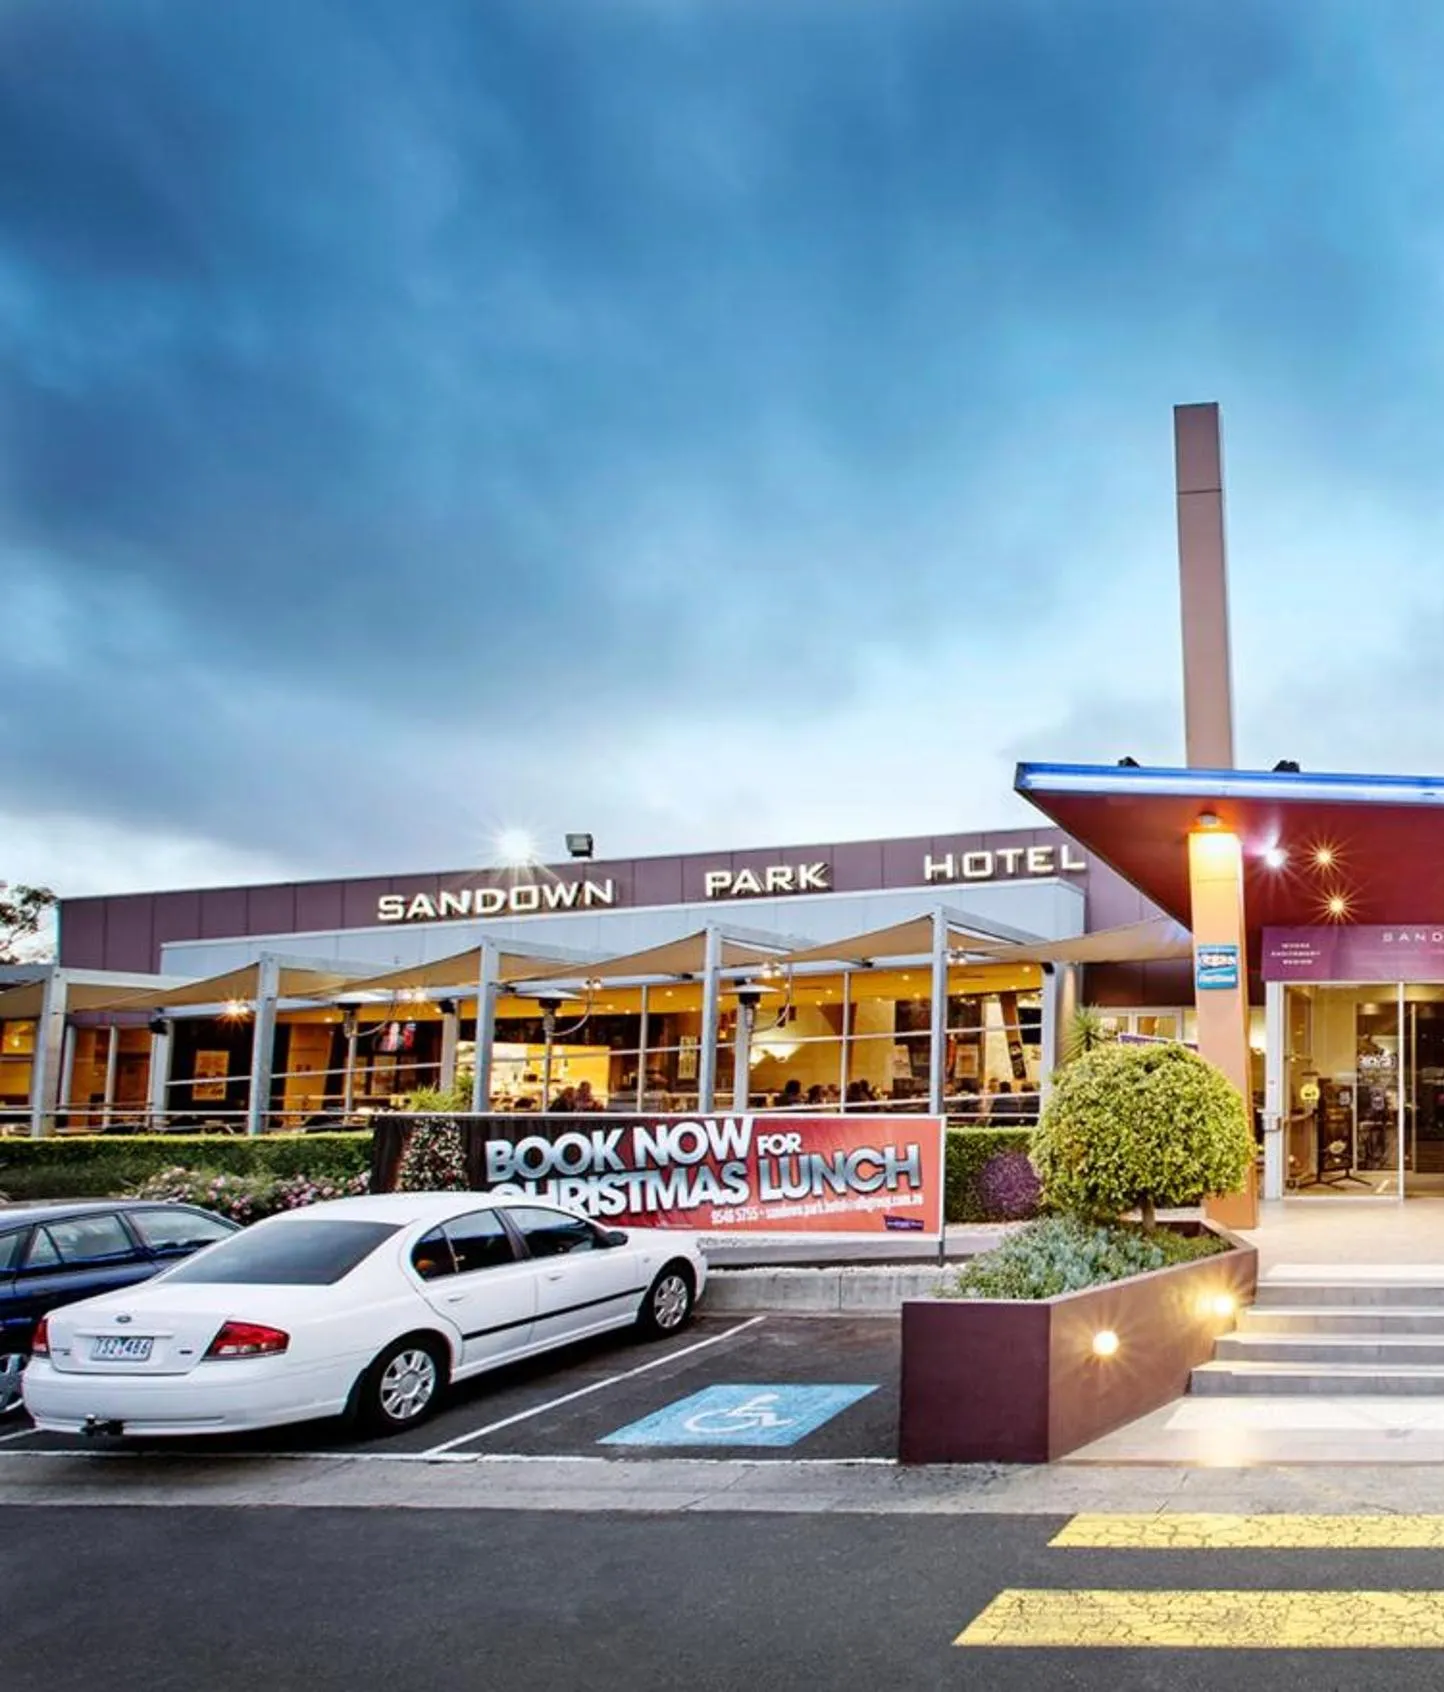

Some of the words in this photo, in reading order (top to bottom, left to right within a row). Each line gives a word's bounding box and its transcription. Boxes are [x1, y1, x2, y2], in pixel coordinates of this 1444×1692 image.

[377, 878, 615, 920] SANDOWN
[704, 861, 831, 897] PARK
[924, 845, 1087, 881] HOTEL
[485, 1128, 626, 1182] BOOK
[632, 1117, 754, 1168] NOW
[757, 1133, 801, 1156] FOR
[758, 1143, 922, 1202] LUNCH
